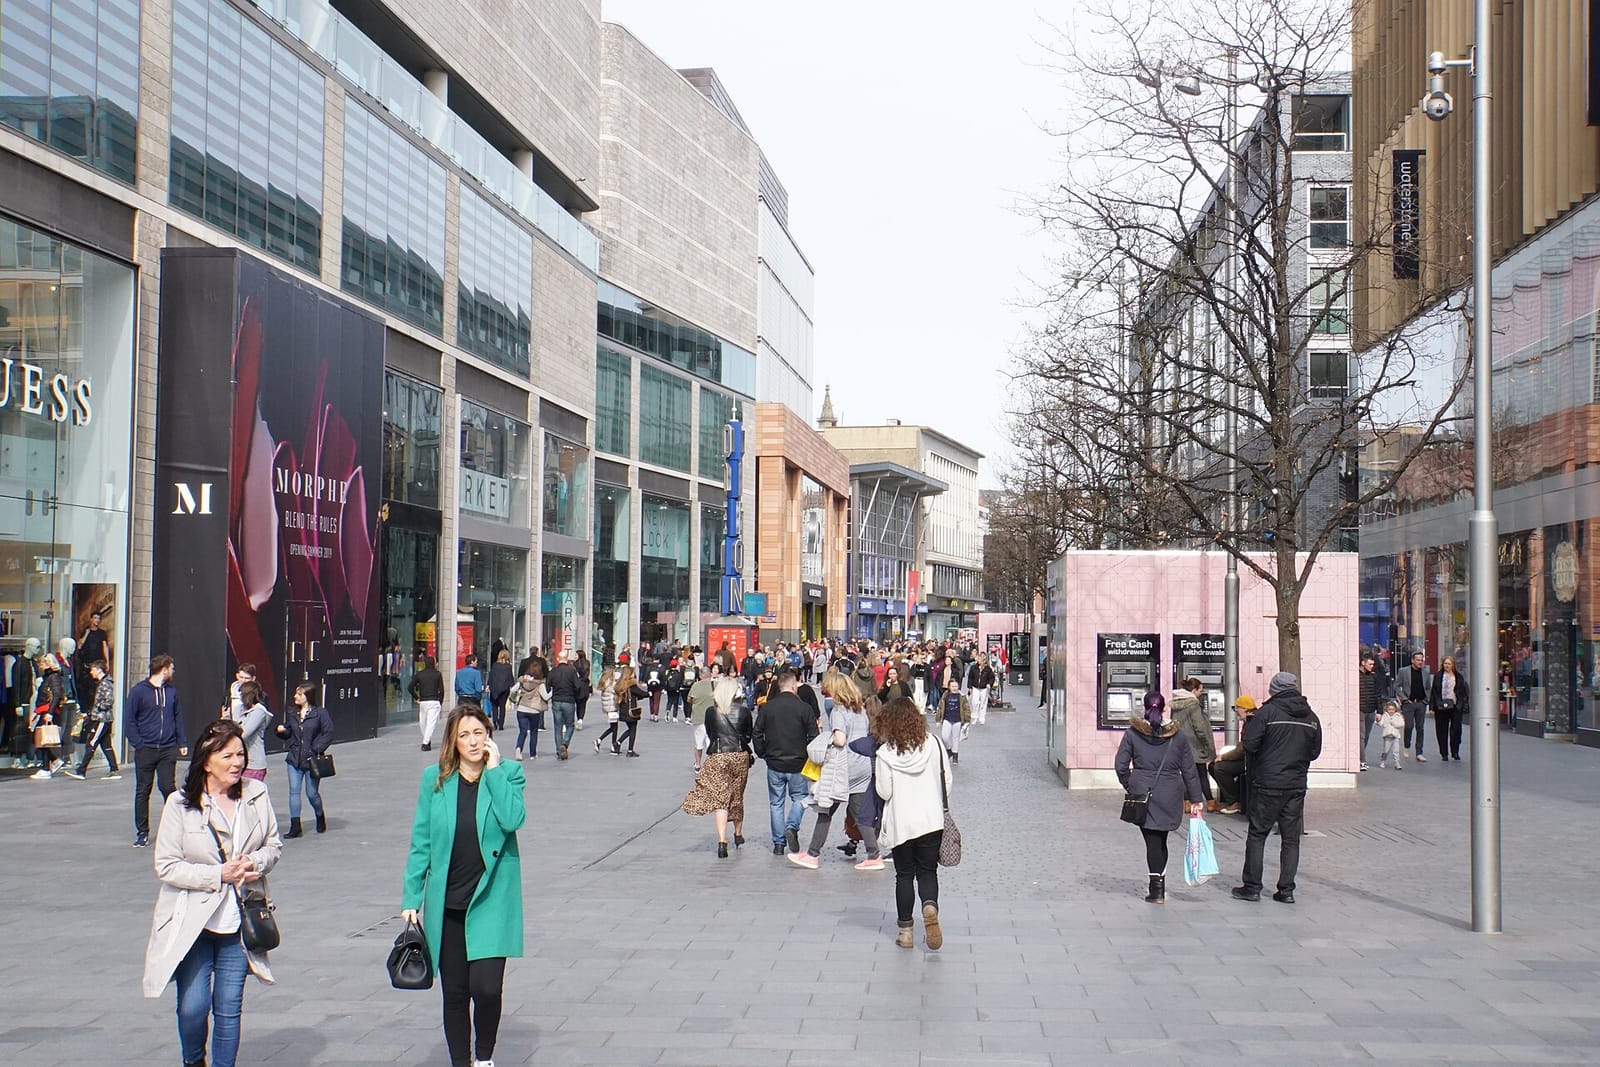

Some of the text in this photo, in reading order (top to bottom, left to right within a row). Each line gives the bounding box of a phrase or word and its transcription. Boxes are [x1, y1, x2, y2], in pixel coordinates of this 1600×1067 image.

[1400, 161, 1413, 247] waterstone
[171, 483, 213, 515] M
[275, 467, 348, 505] MORPHE
[464, 474, 507, 512] RKET
[285, 510, 337, 533] BLEND THE RULES
[290, 543, 307, 557] OPENING
[307, 545, 323, 558] SUMMER
[1105, 639, 1153, 649] Free Cash
[1180, 639, 1202, 649] Free
